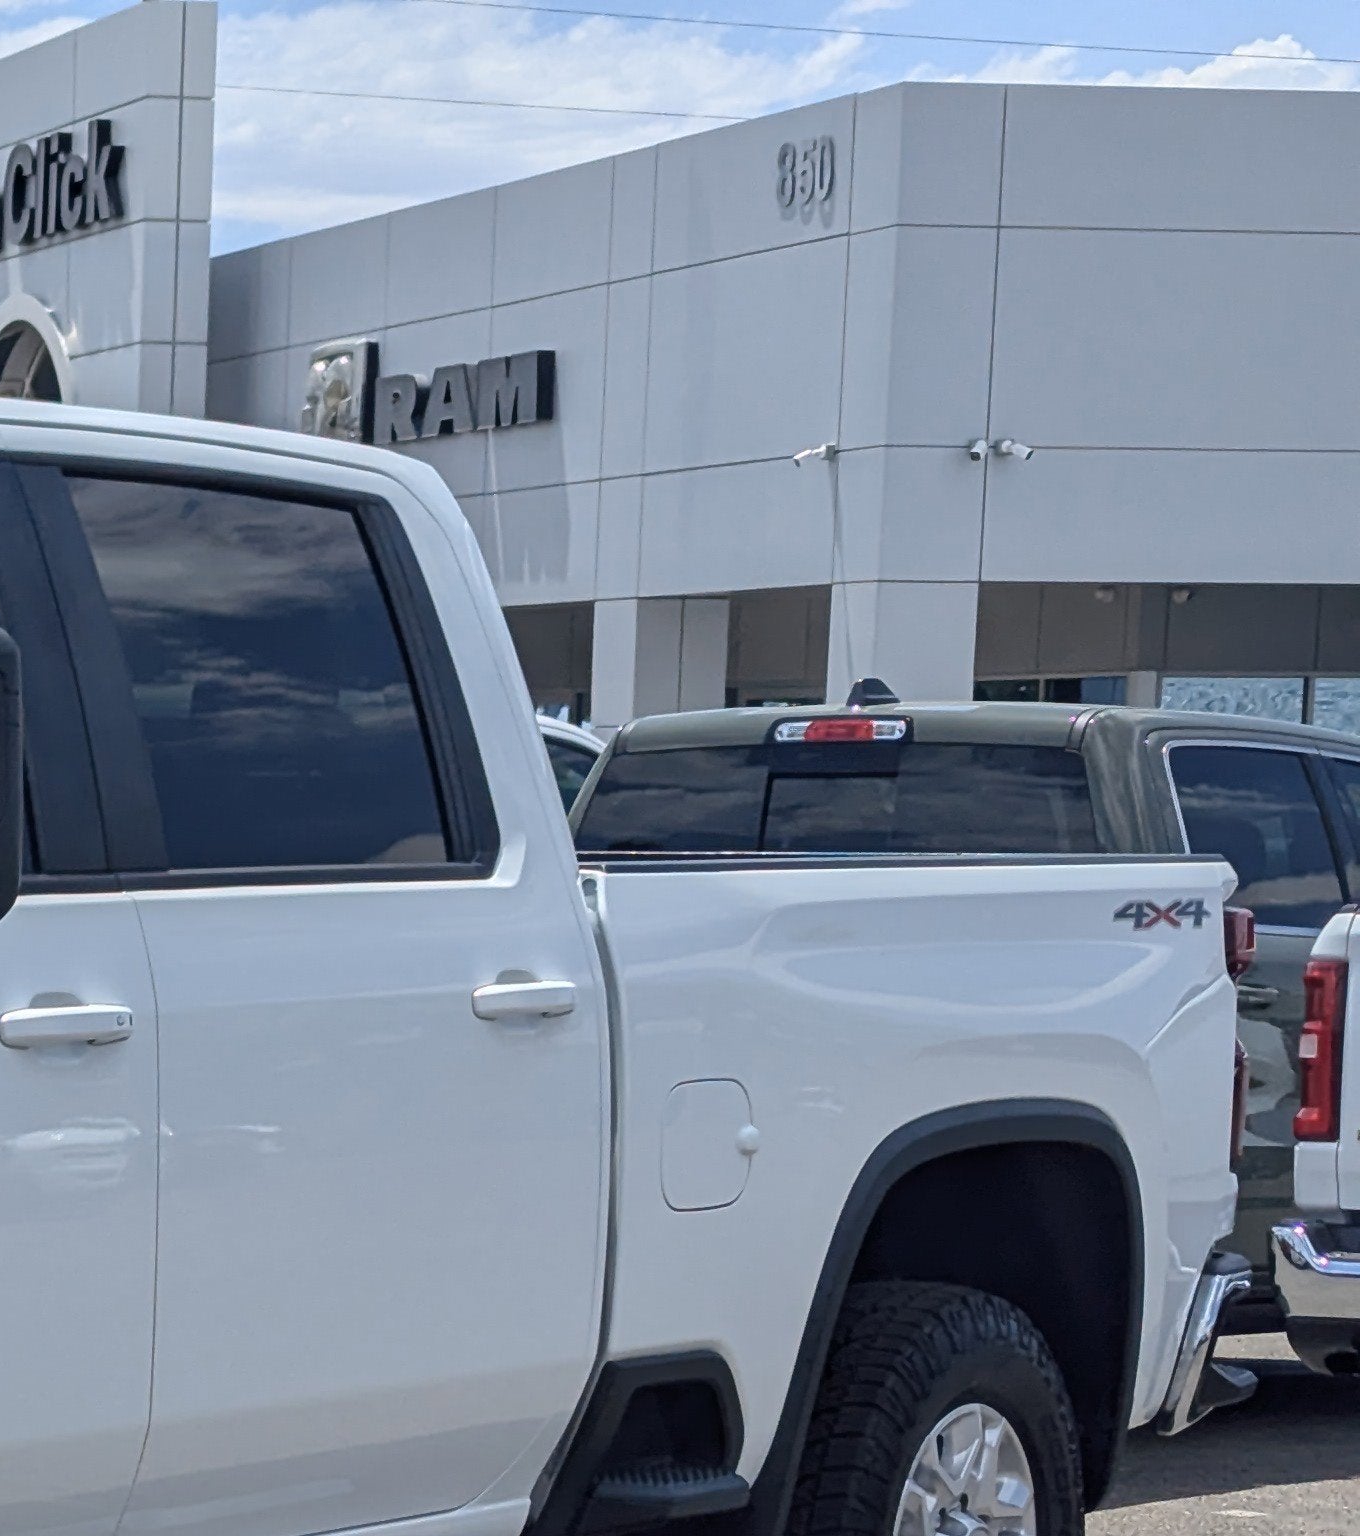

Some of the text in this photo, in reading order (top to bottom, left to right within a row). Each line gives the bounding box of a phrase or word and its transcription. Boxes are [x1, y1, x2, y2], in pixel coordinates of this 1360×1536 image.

[4, 119, 118, 246] Click
[776, 136, 836, 208] 850
[374, 350, 548, 444] RAM
